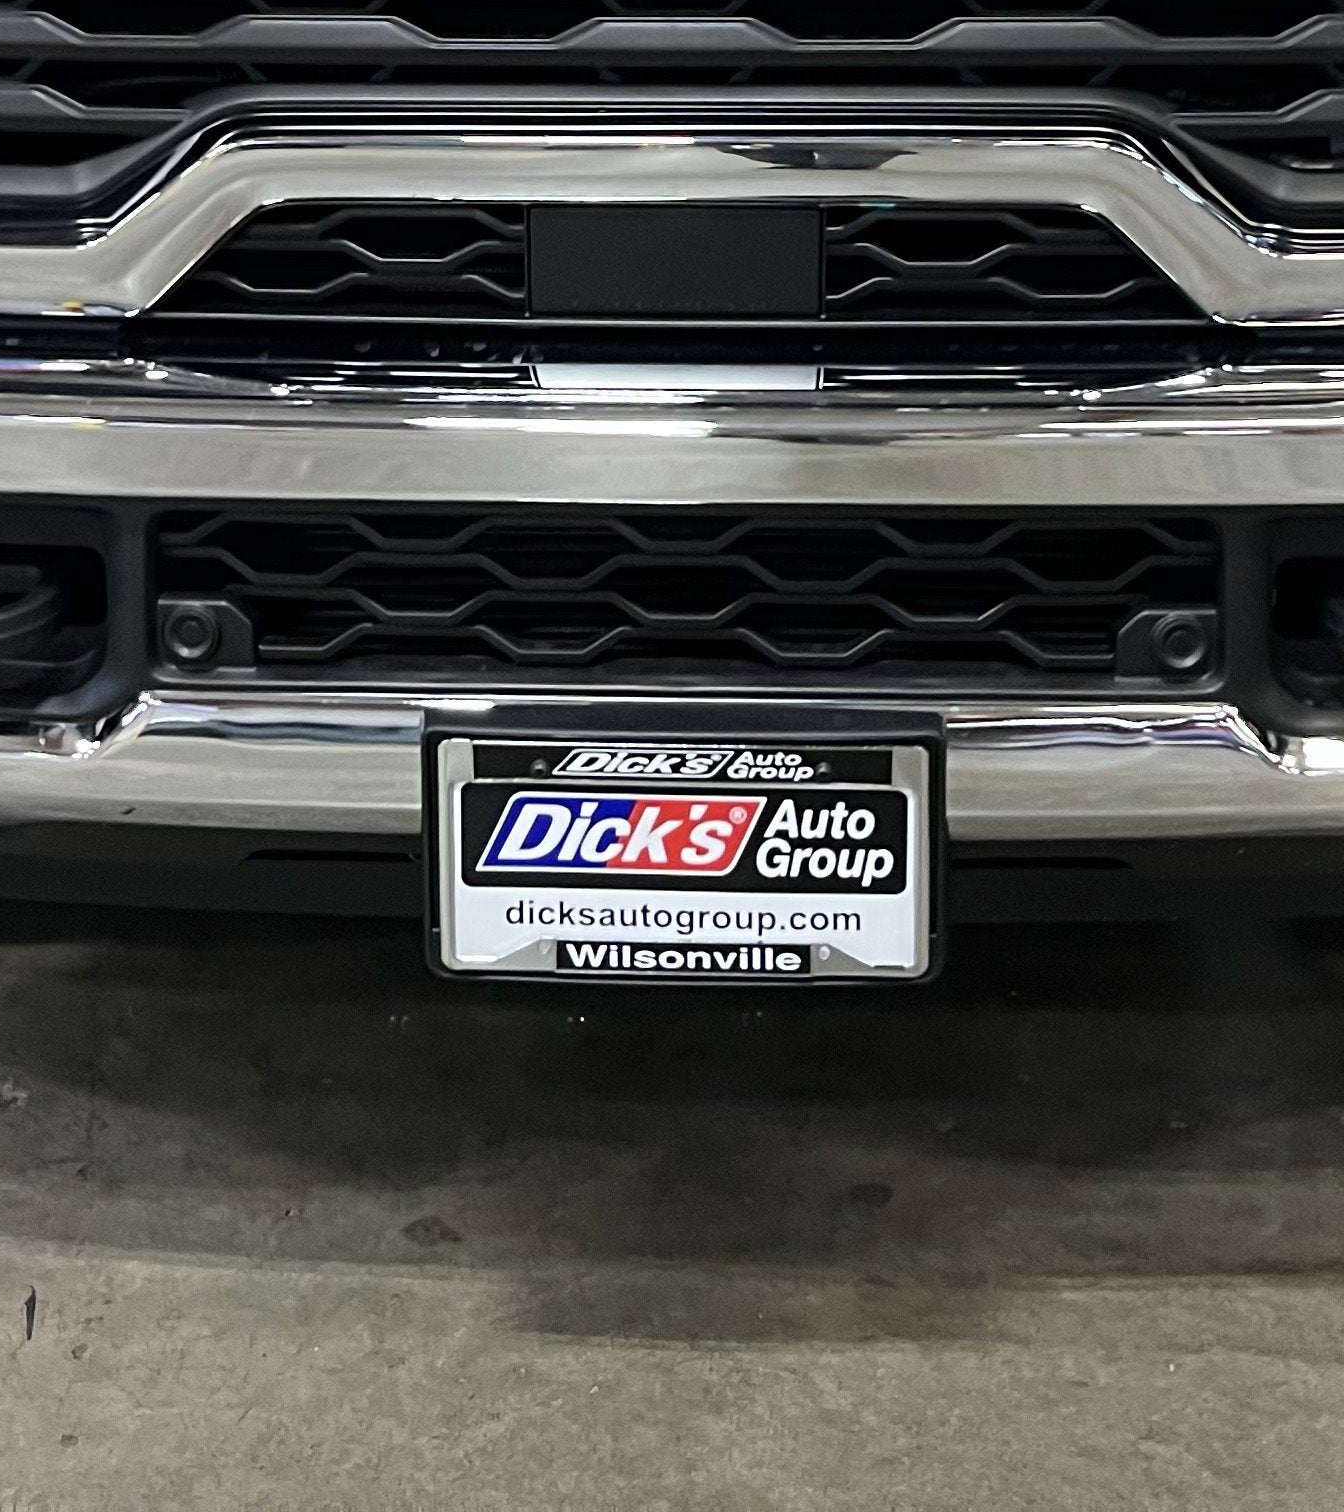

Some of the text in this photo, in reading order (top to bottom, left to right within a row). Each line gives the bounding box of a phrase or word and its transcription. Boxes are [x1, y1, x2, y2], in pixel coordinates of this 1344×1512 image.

[727, 764, 814, 781] Group
[739, 751, 803, 766] Auto
[764, 799, 876, 840] Auto
[755, 839, 894, 887] Group
[505, 900, 862, 936] dicksautogroup.com
[565, 943, 802, 971] Wilsonville
